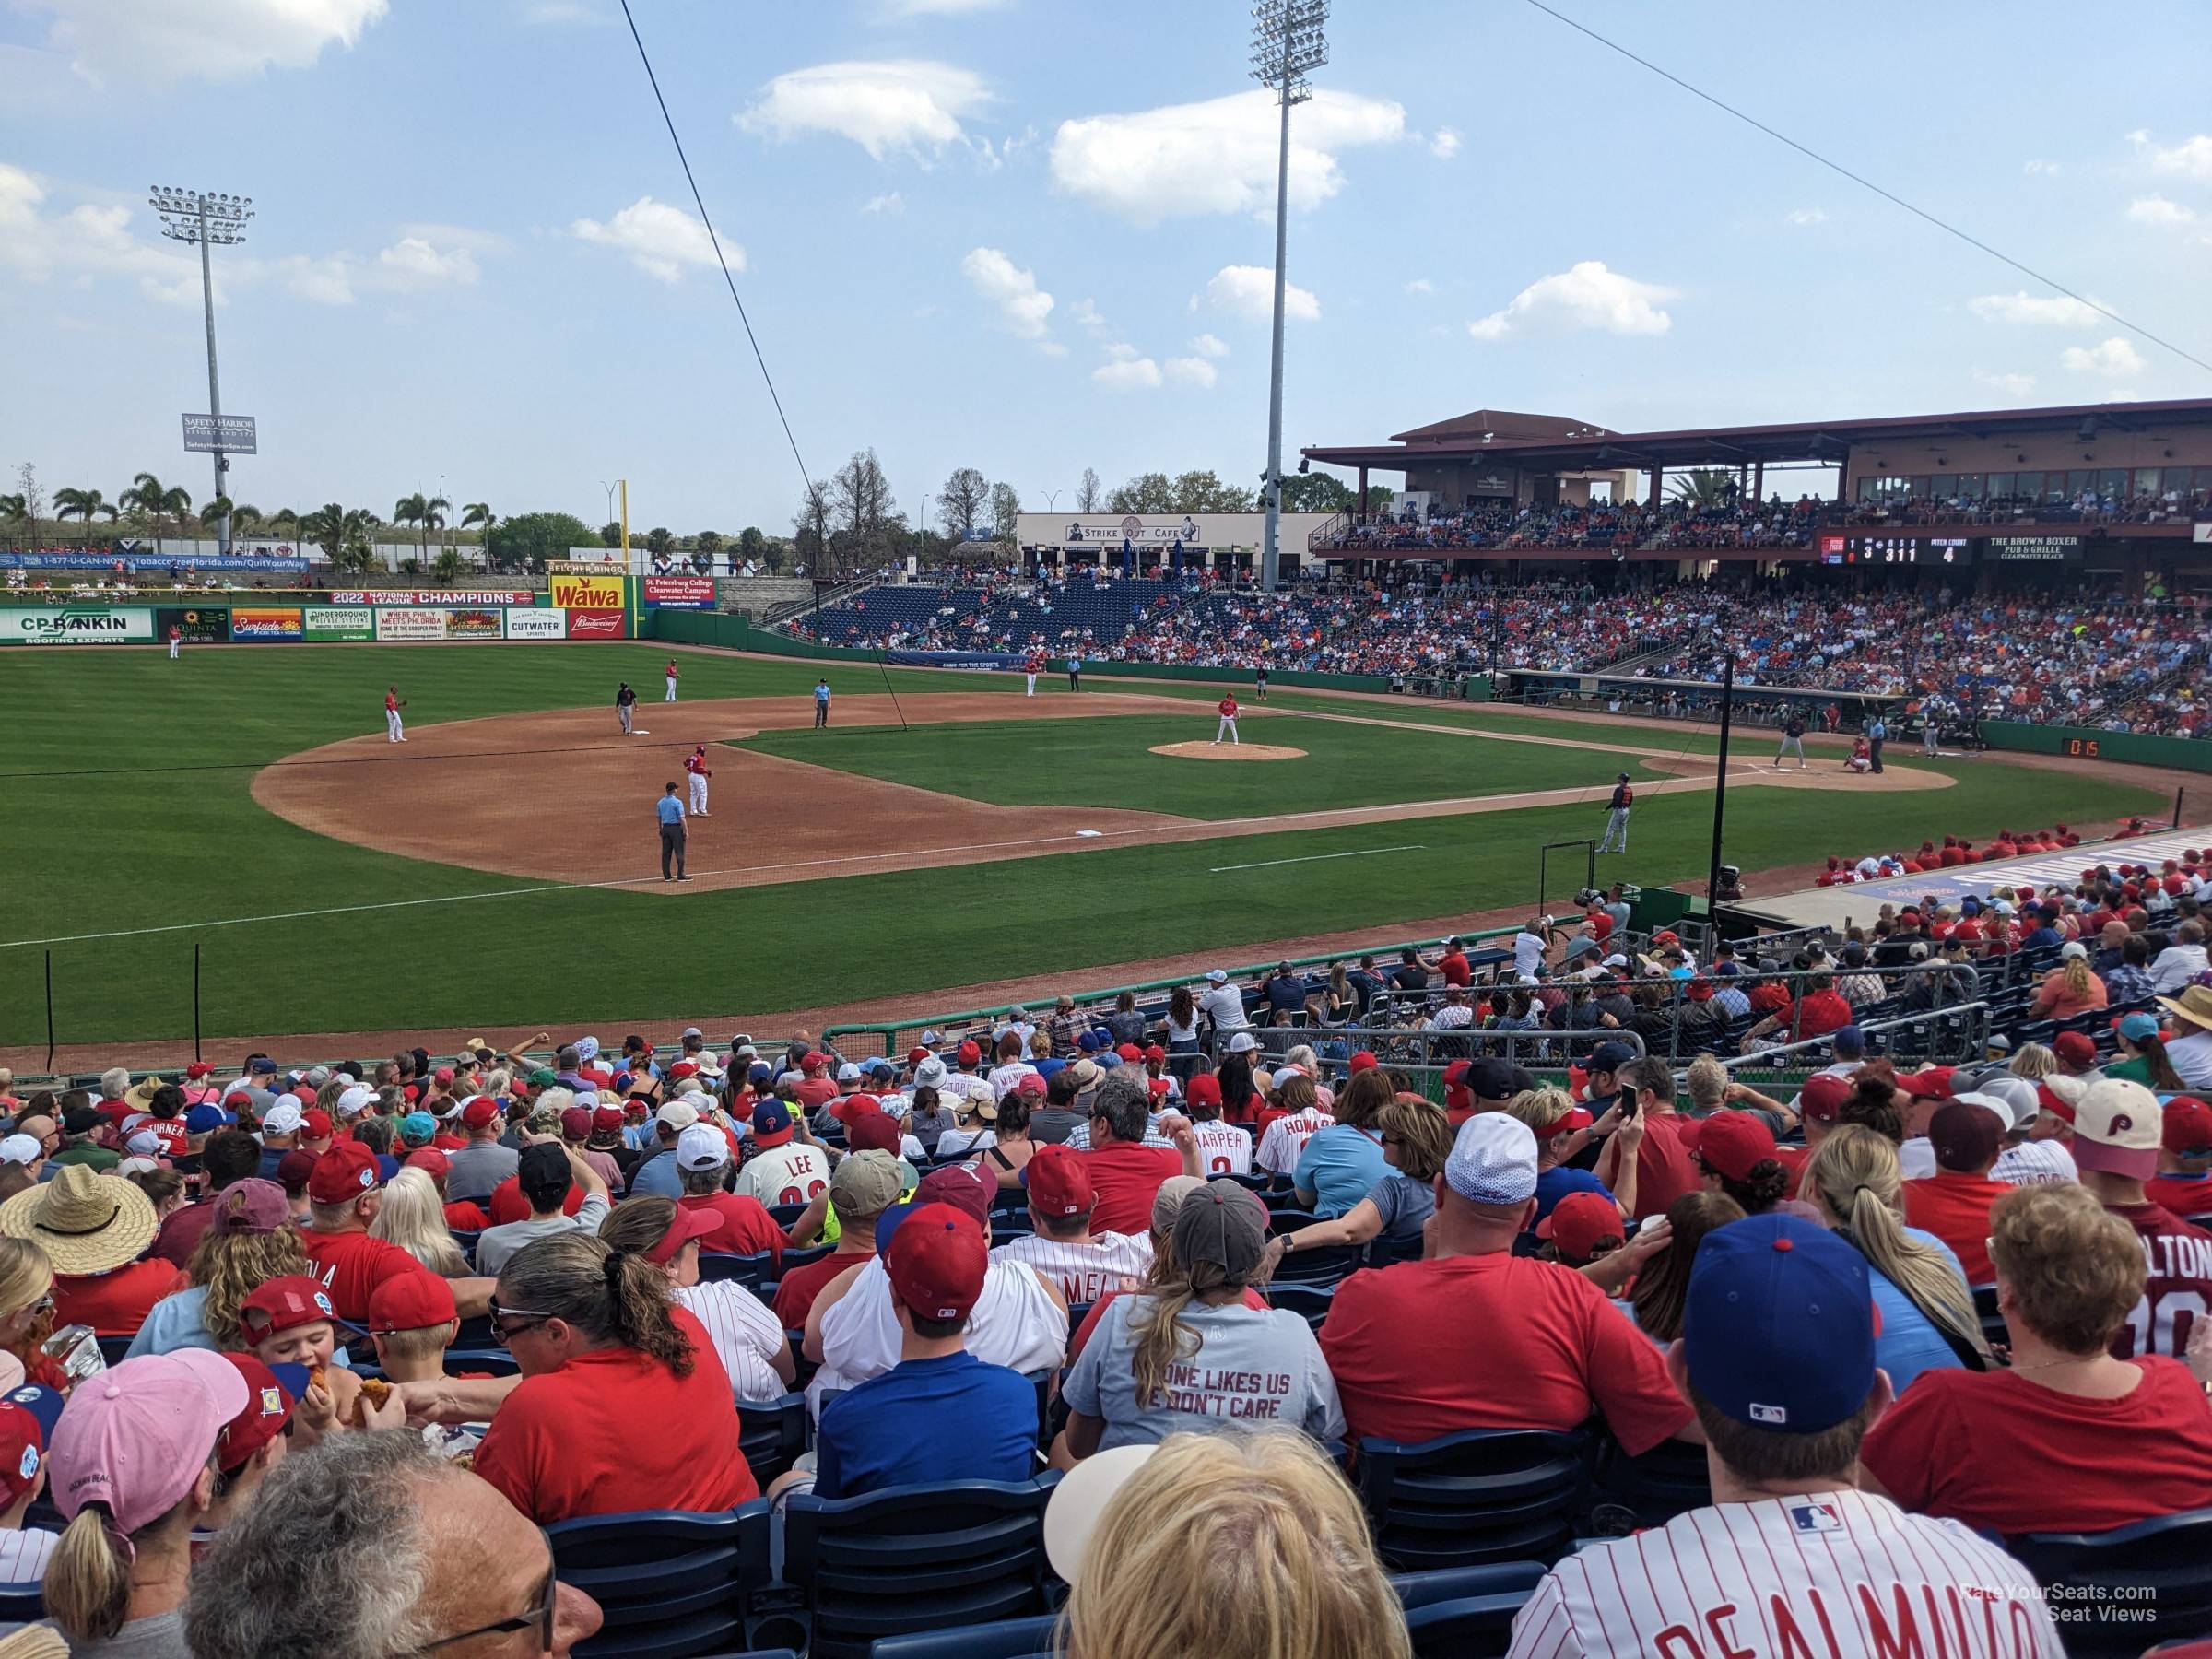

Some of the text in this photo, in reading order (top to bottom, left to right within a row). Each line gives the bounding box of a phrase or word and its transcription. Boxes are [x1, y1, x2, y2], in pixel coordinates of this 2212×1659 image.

[1085, 529, 1118, 537] STRIKE
[1126, 529, 1146, 537] OUT
[1991, 537, 2077, 546] THE BROWN BOXER
[594, 565, 623, 573] BINGO
[655, 579, 688, 587] Petersburg
[333, 593, 364, 603] 2022
[418, 593, 514, 604] CHAMPIONS
[556, 585, 618, 606] Wawa
[234, 617, 280, 634] Surfside
[512, 622, 559, 630] CUTWATER
[577, 618, 617, 627] Budweiser
[148, 1123, 184, 1137] TURNER
[785, 1154, 813, 1179] LEE
[1204, 1369, 1262, 1394] LIKES
[1266, 1373, 1290, 1395] US
[1166, 1388, 1226, 1417] DON'T
[1230, 1396, 1281, 1419] CARE
